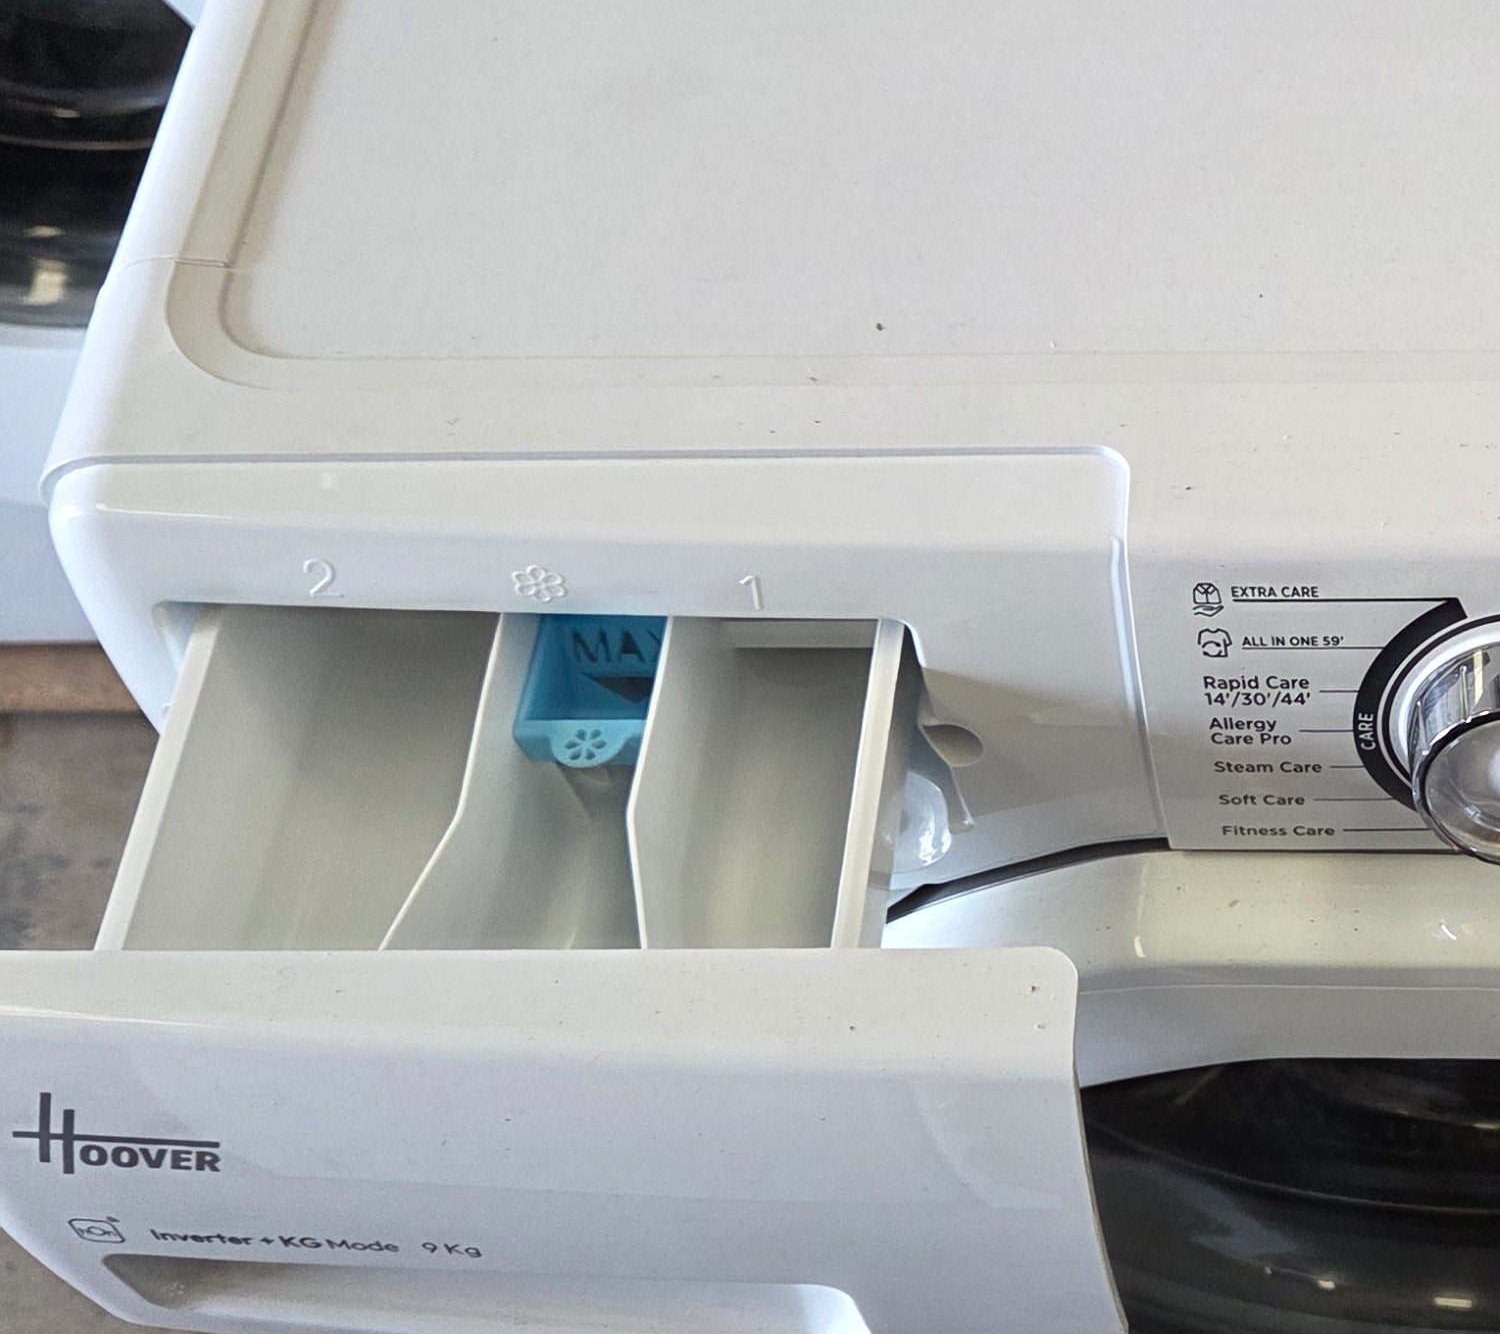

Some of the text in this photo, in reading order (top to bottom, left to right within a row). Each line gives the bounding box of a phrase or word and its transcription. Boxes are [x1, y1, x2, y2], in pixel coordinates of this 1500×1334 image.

[303, 557, 345, 599] 2
[738, 574, 765, 611] 1
[1230, 585, 1320, 598] EXTRA CARE
[1242, 636, 1267, 647] ALL
[1271, 635, 1285, 646] IN
[1289, 636, 1319, 647] ONE
[1203, 675, 1310, 693] Rapid Care
[1209, 717, 1277, 733] Allergy
[1358, 712, 1376, 751] CARE
[1210, 733, 1292, 745] Care Pro
[1214, 760, 1322, 773] Steam Care
[1218, 794, 1305, 806] Soft Care
[1222, 825, 1335, 837] Fitness Care
[443, 1243, 482, 1258] Kg
